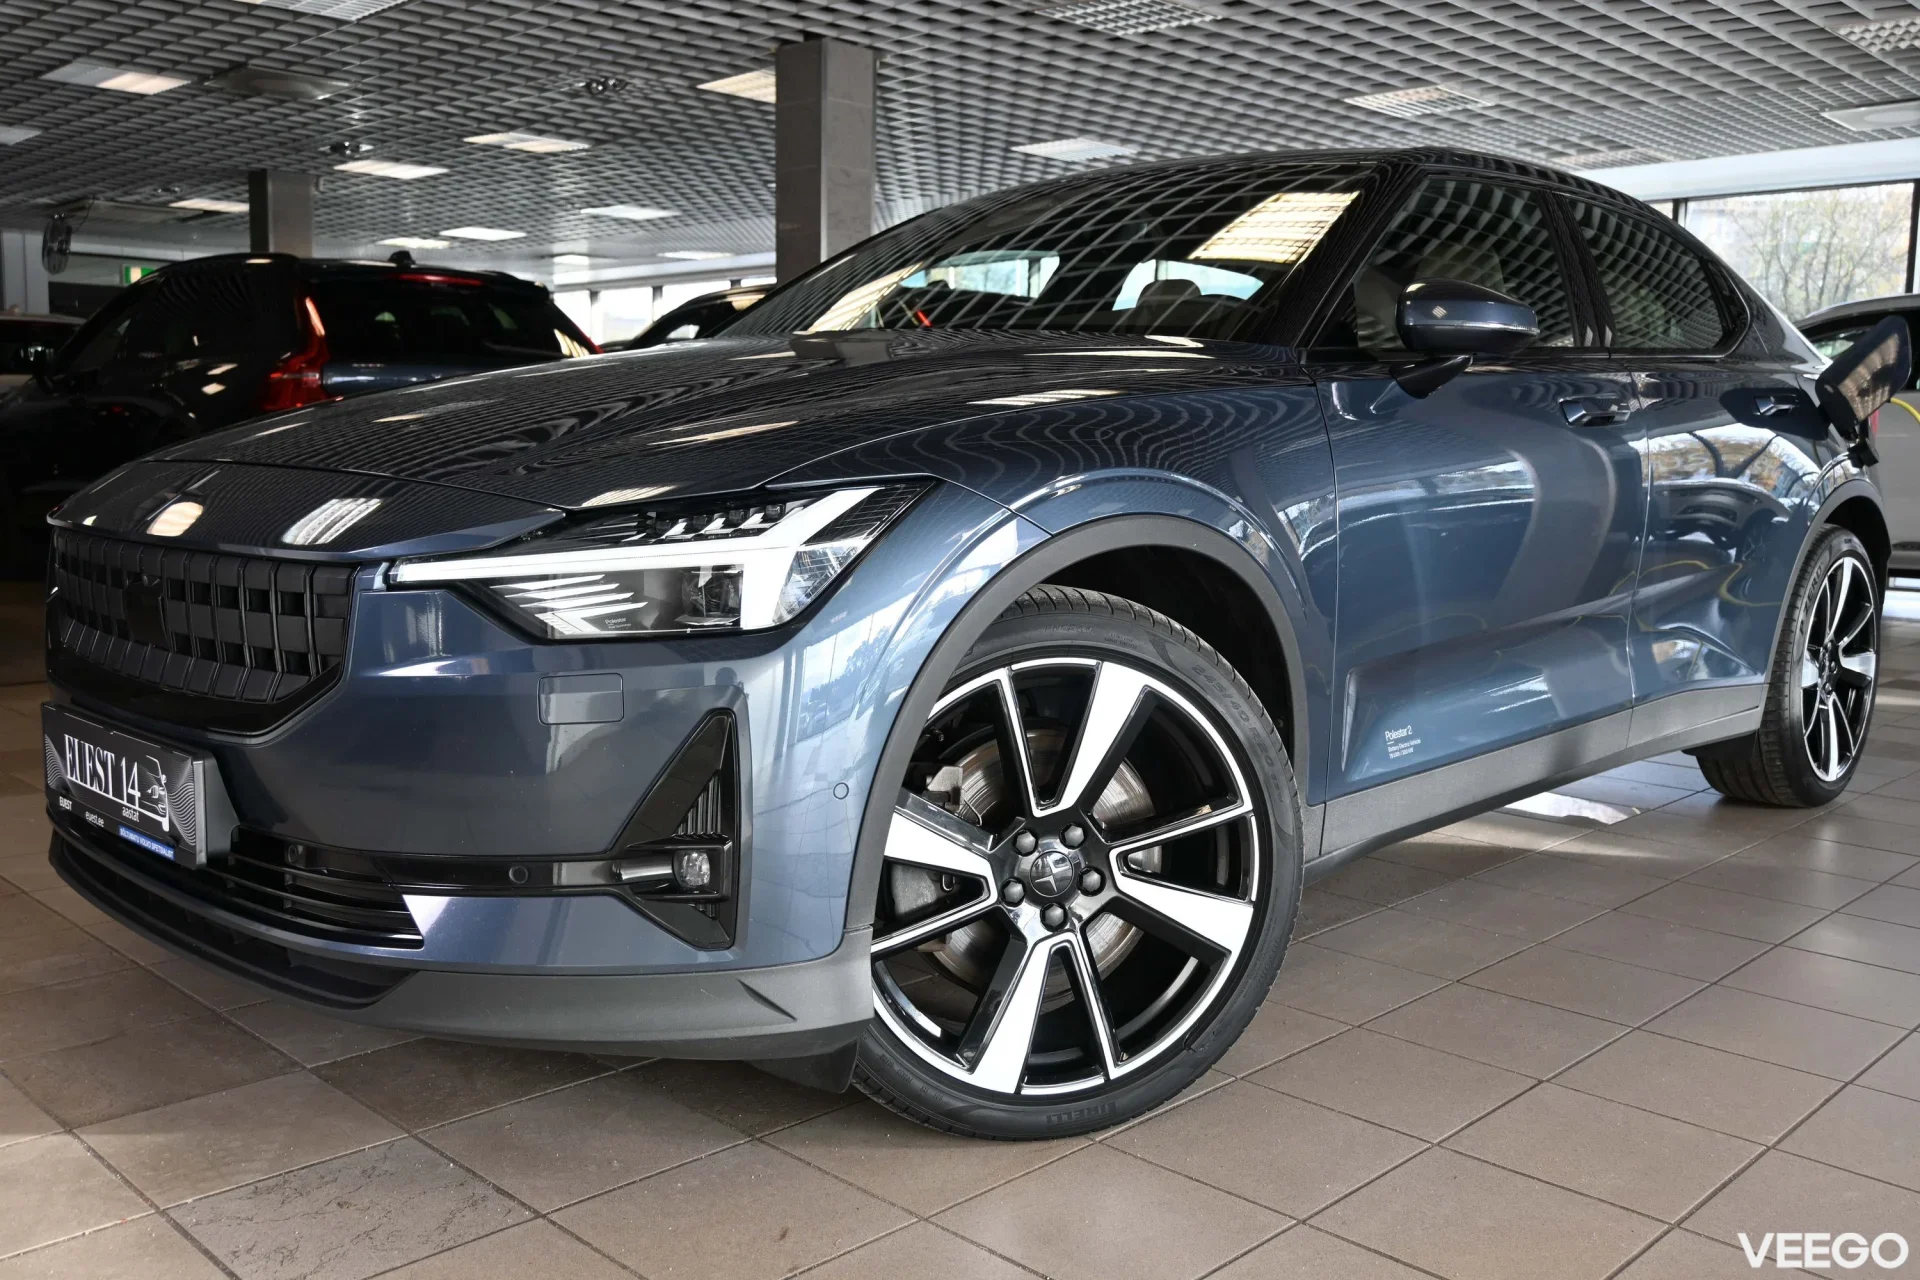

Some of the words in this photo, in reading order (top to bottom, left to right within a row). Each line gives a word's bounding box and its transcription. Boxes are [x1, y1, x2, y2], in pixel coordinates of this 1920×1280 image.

[1385, 728, 1407, 741] Polestar
[1407, 725, 1412, 735] 2
[64, 733, 116, 798] EUEST
[120, 756, 142, 809] 14
[59, 796, 73, 811] EUEST
[85, 810, 105, 828] euest.ee
[122, 806, 140, 823] aastat
